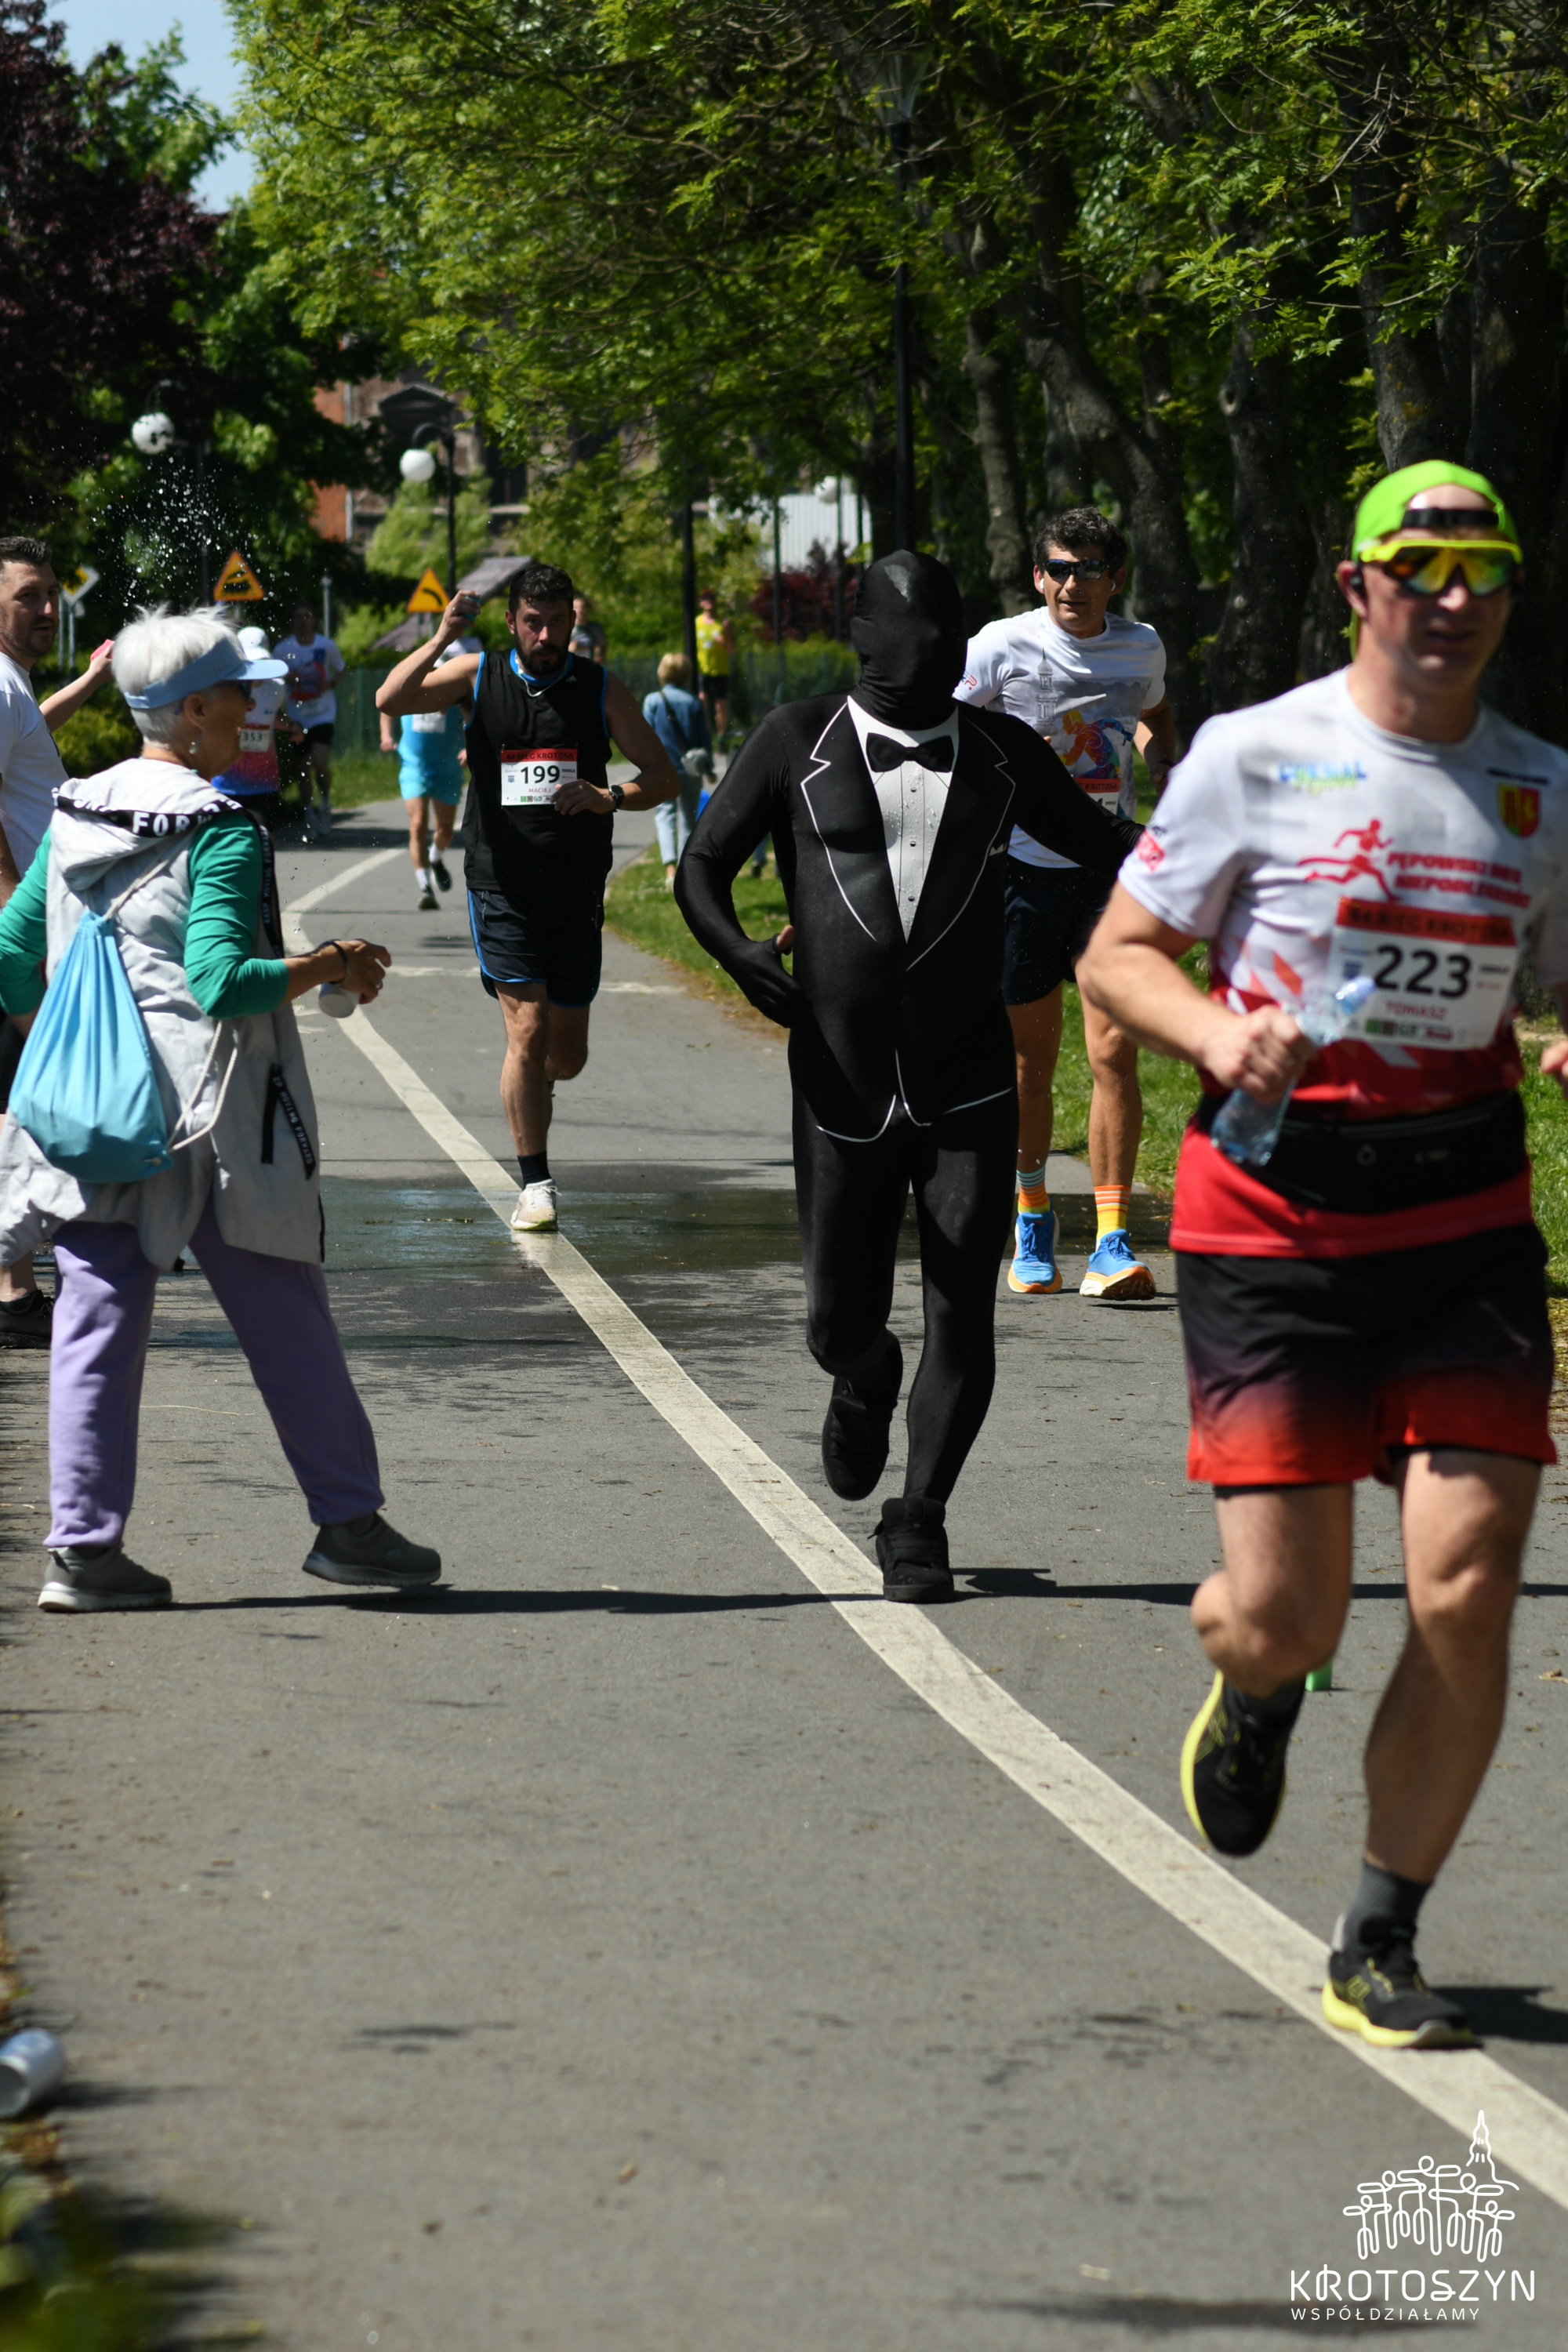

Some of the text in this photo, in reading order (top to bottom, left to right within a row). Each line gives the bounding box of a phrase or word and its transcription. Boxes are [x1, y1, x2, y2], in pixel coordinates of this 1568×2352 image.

[521, 765, 560, 784] 199
[1377, 909, 1421, 932] BIEG
[1374, 943, 1472, 1000] 223
[1385, 1000, 1447, 1021] TOMASZ
[295, 1126, 314, 1164] FORWARD
